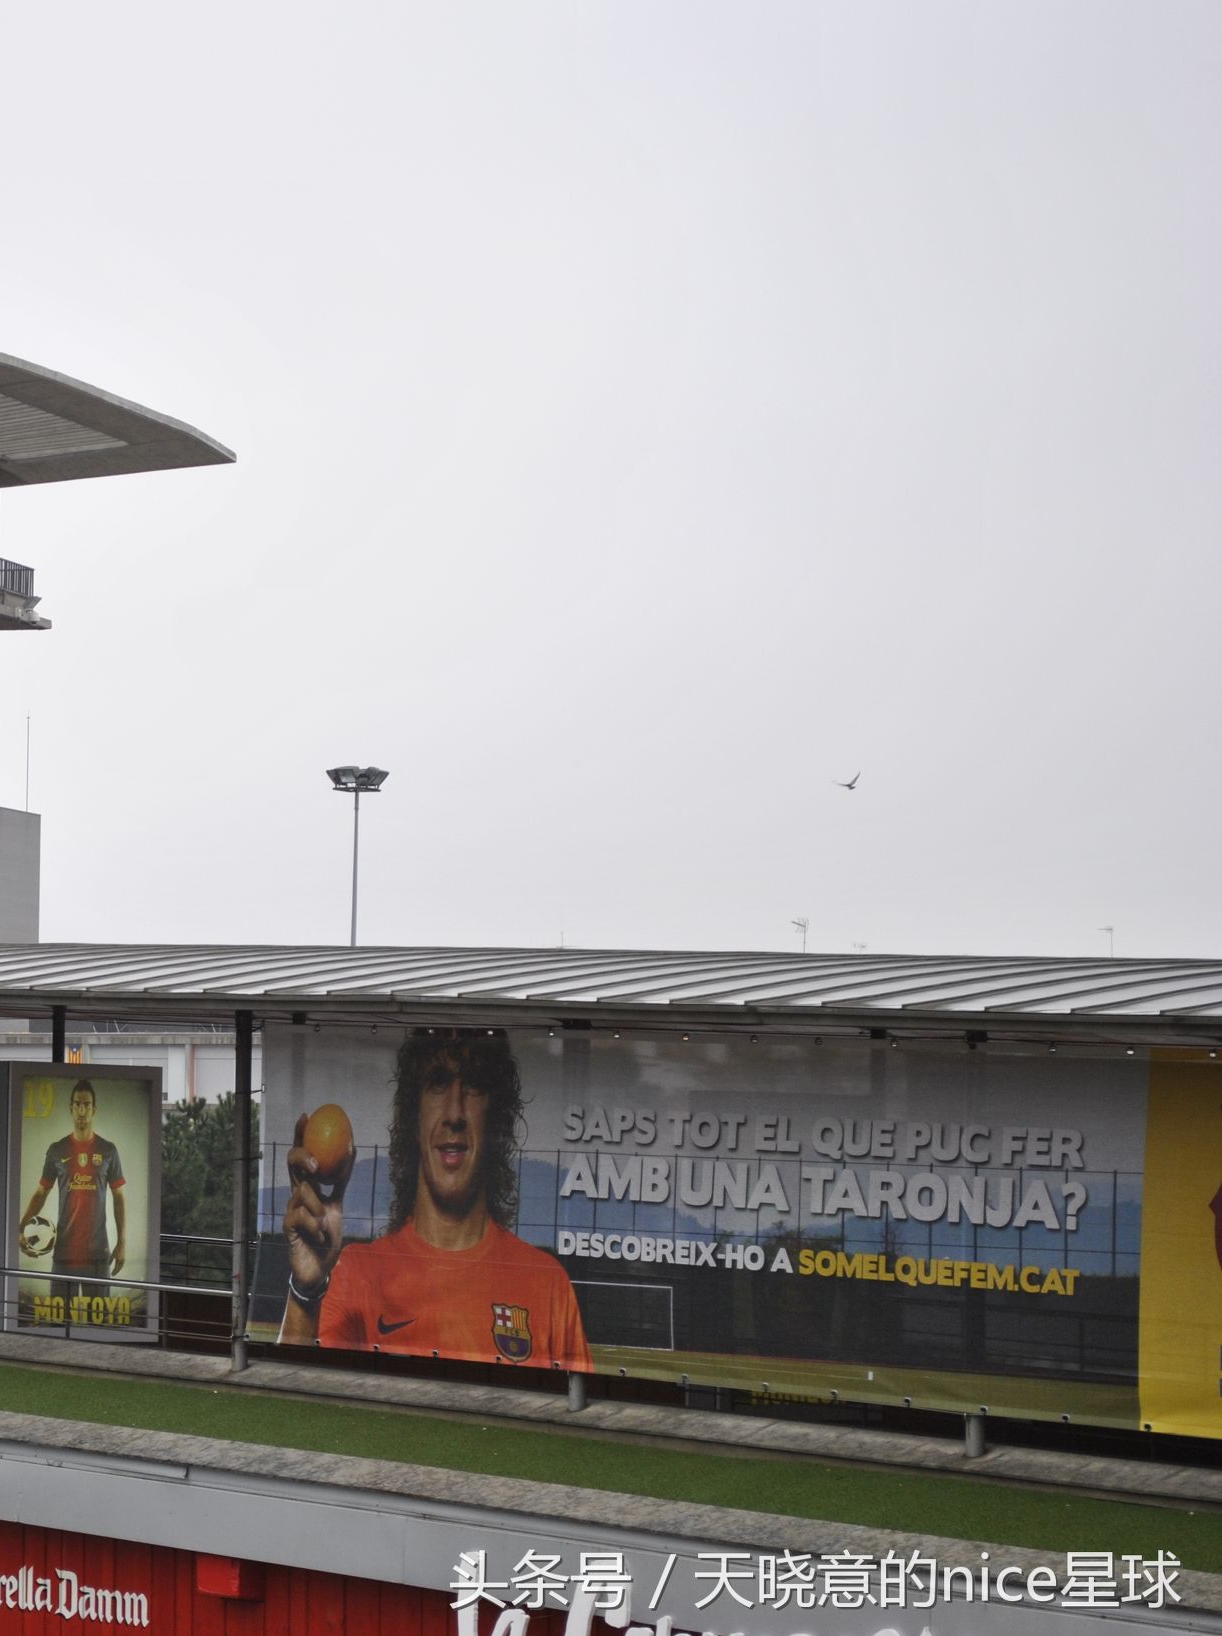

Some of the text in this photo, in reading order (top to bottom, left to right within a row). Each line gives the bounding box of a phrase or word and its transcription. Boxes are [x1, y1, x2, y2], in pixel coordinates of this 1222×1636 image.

[24, 1079, 56, 1118] 19
[563, 1105, 1085, 1168] SAPS TOT EL QUE PUC FER
[559, 1152, 1087, 1231] AMB UNA TARONJA?
[558, 1231, 766, 1272] DESCOBREIX-HO
[770, 1247, 794, 1274] A
[54, 1567, 150, 1628] Damm
